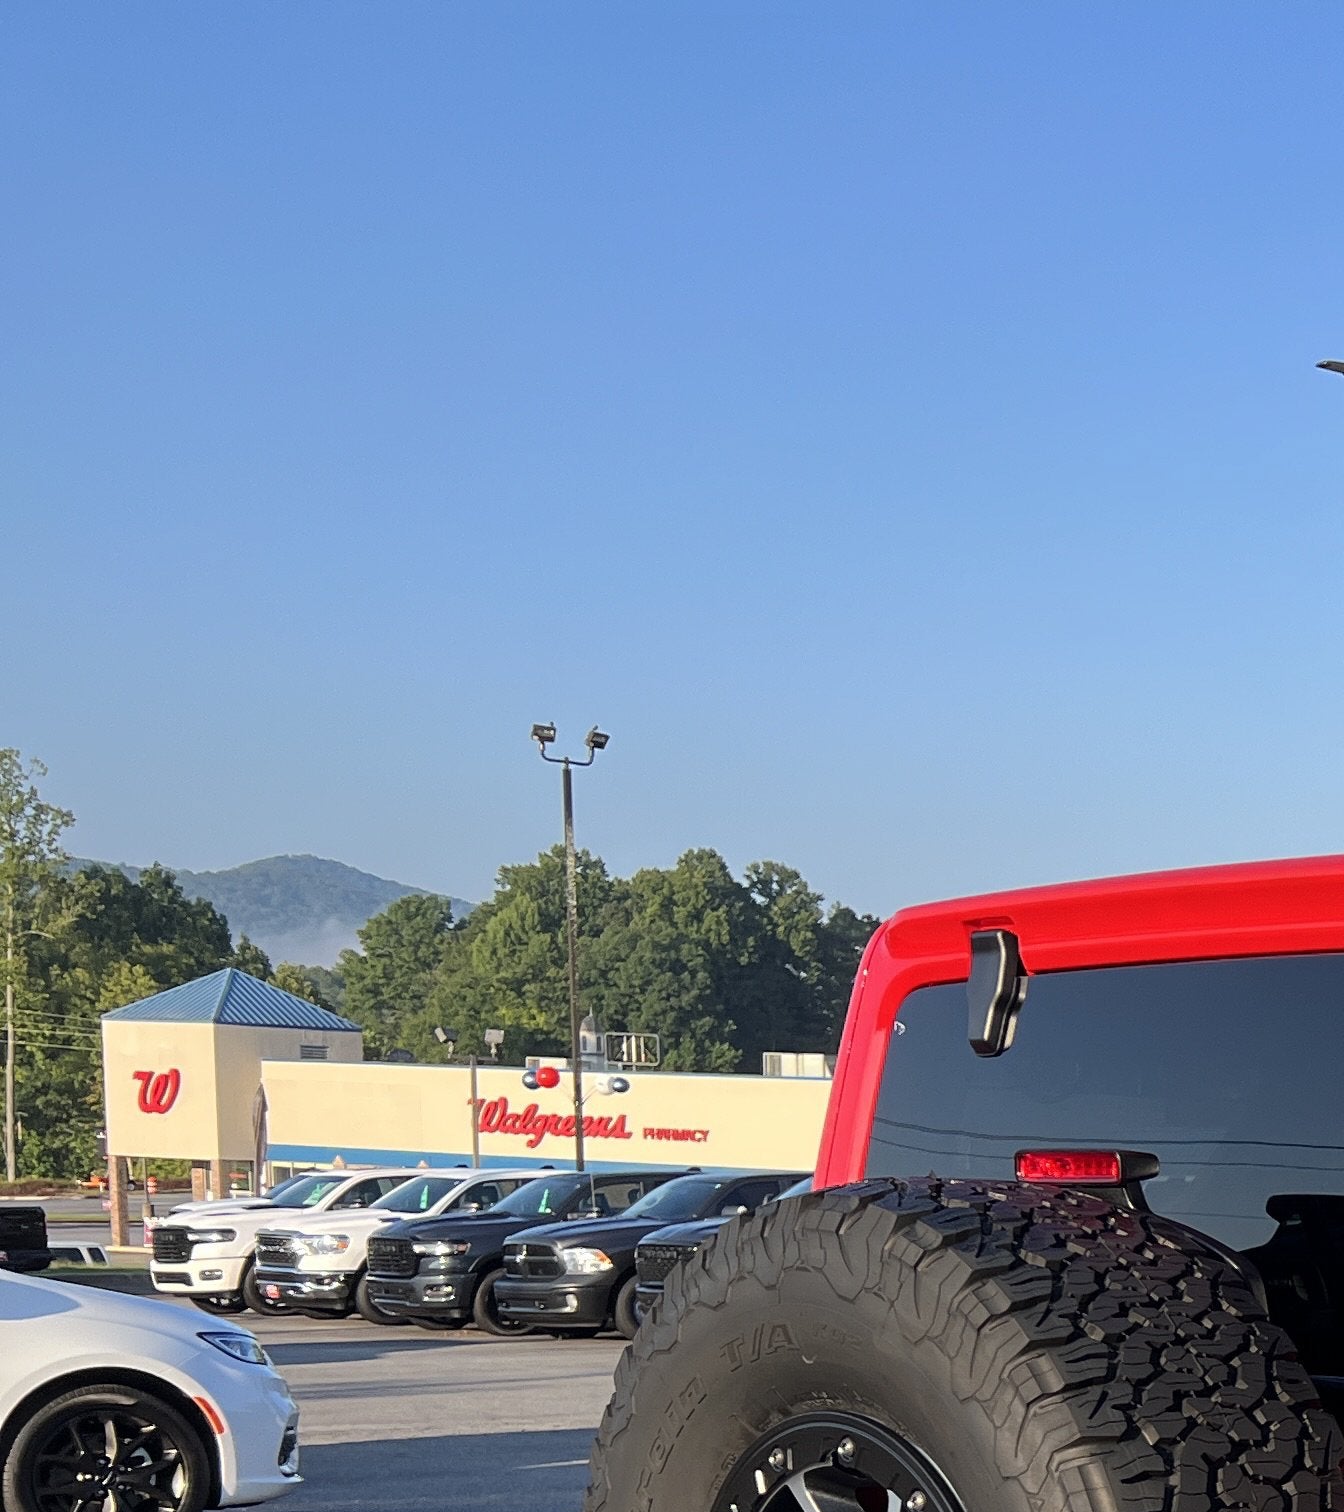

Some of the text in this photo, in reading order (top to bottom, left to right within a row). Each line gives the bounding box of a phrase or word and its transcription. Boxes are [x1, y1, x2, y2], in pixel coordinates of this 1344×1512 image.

[132, 1068, 181, 1114] W
[467, 1096, 710, 1148] Walgreens PHARMACY
[719, 1322, 800, 1373] T/A
